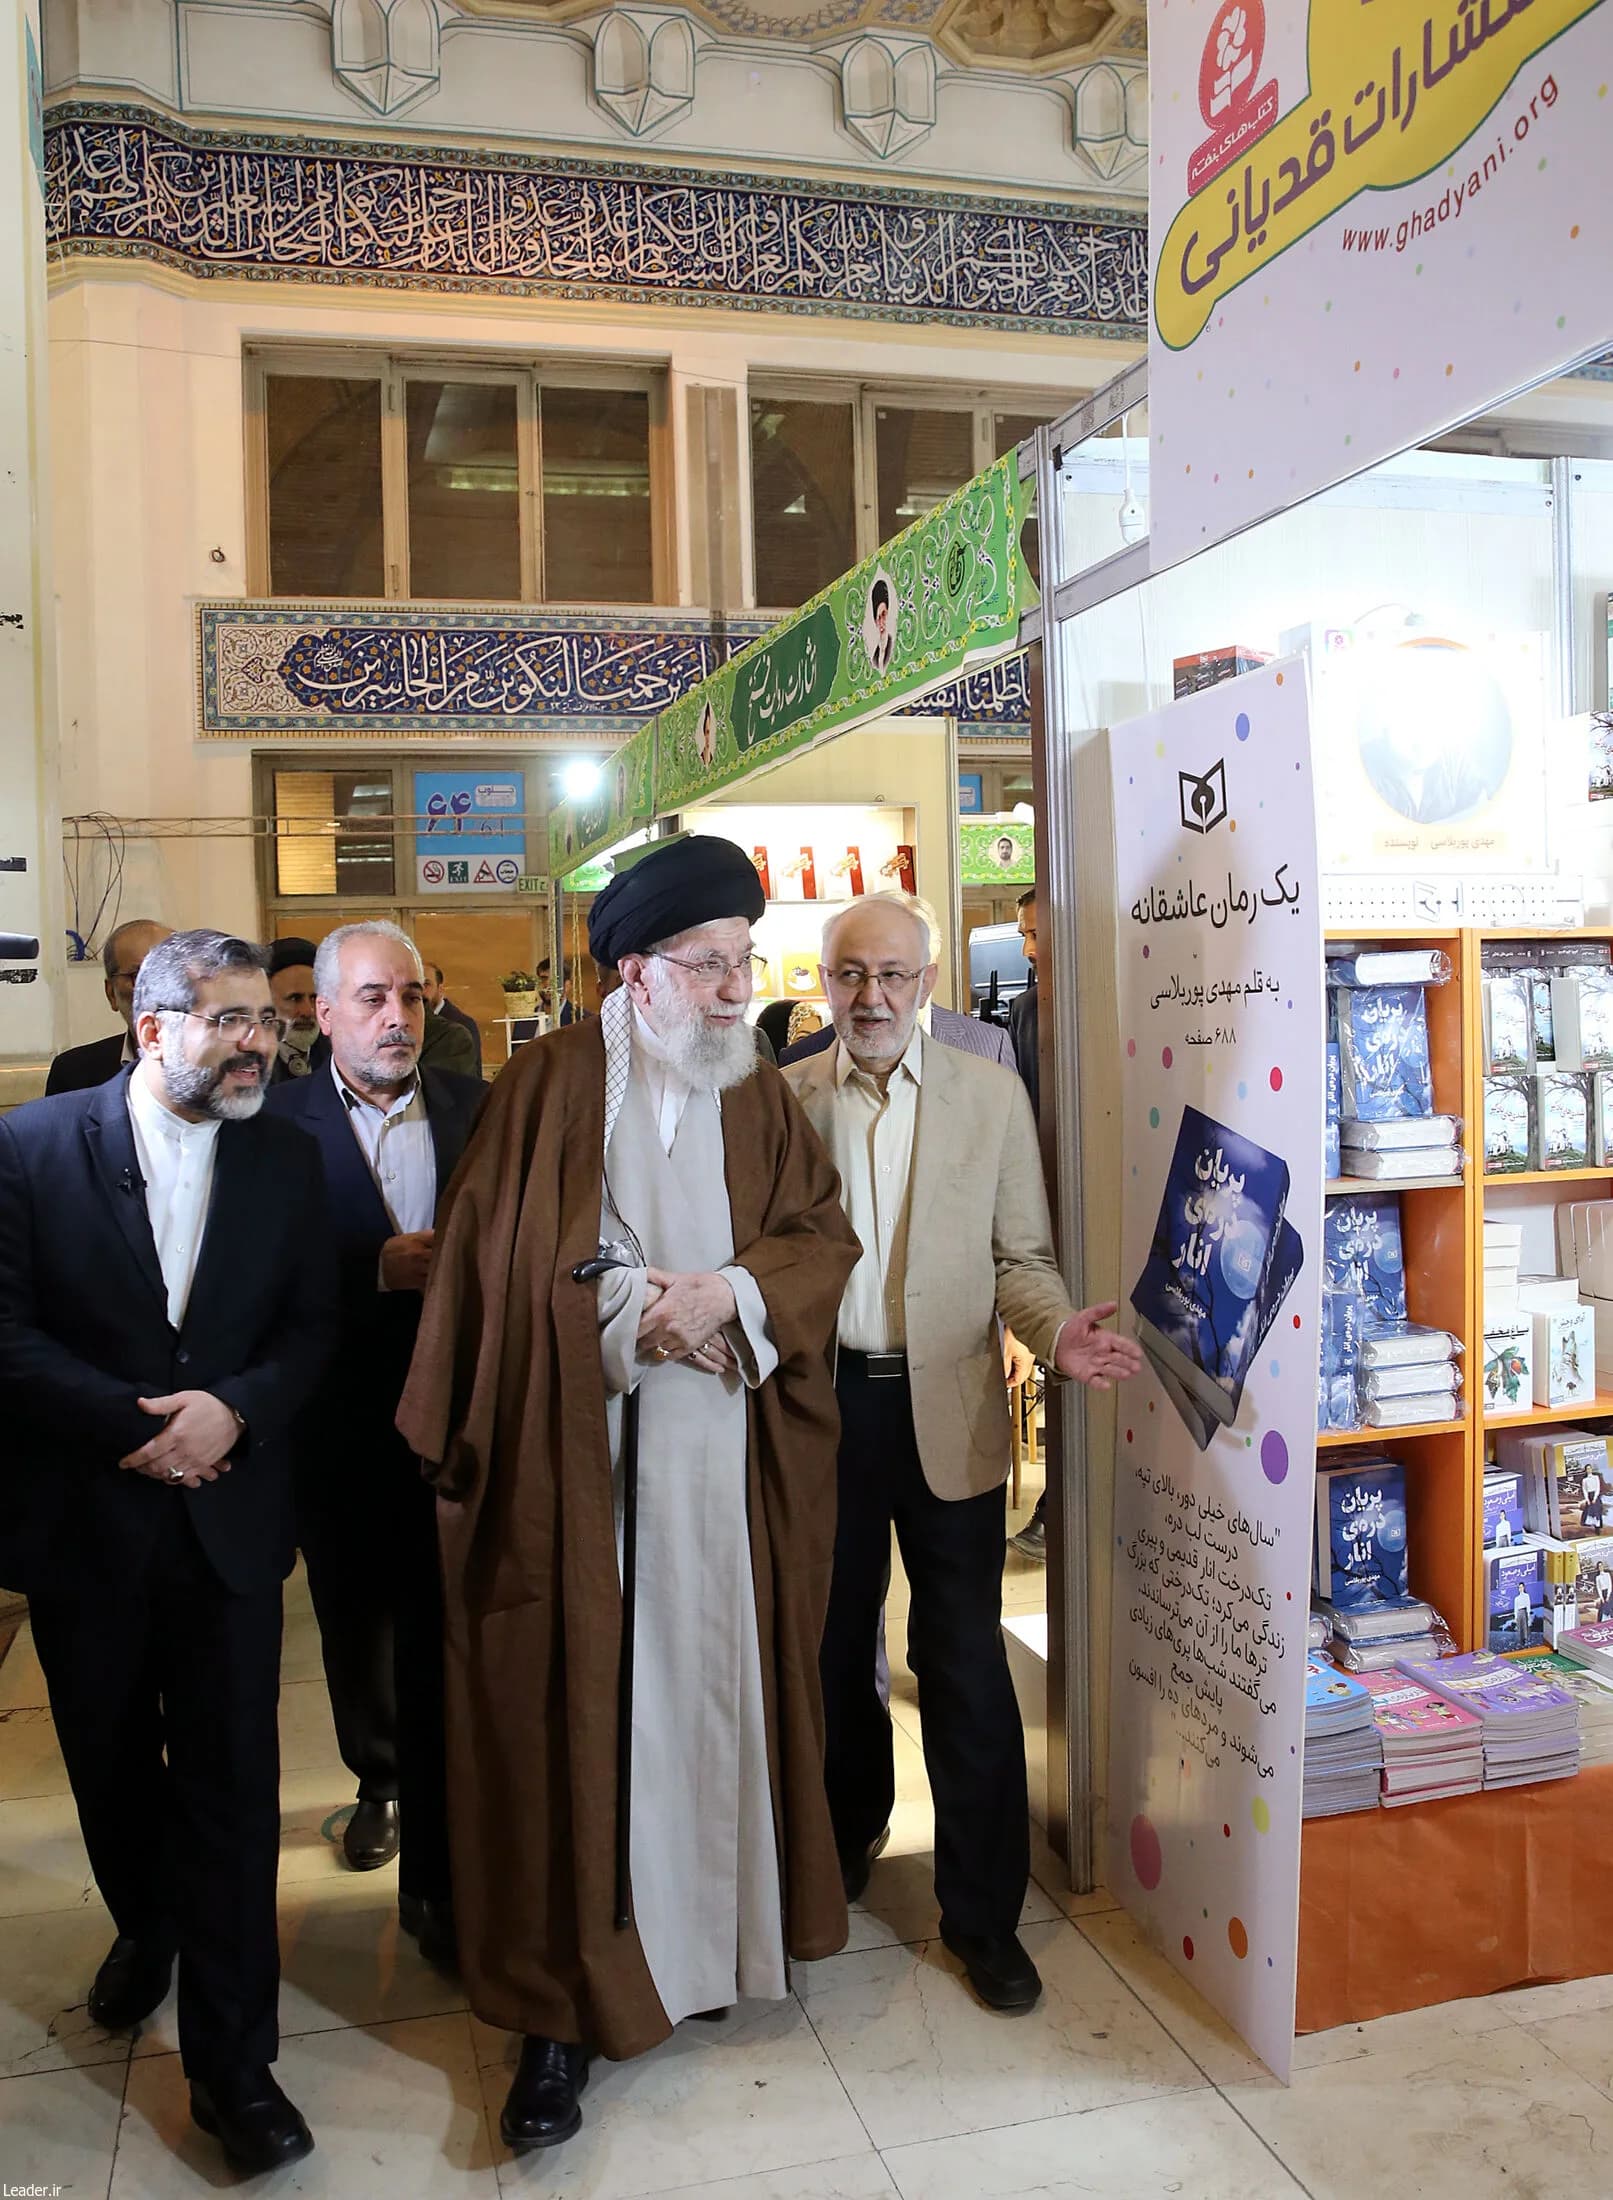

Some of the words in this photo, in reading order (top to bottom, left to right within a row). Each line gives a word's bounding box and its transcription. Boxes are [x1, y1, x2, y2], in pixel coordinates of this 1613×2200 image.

[1342, 74, 1558, 252] www.ghadyani.org
[1181, 108, 1335, 295] قدیانی
[519, 878, 538, 891] EXIT
[1260, 863, 1300, 915] یک
[1131, 880, 1208, 924] عاشقانه
[1210, 872, 1257, 929] رمان
[1150, 973, 1205, 1010] پوربلاسی
[1206, 979, 1242, 1003] مهدی
[1243, 968, 1264, 1008] قلم
[1265, 975, 1280, 1002] به
[1184, 1028, 1213, 1046] صفحه
[1214, 1027, 1237, 1044] ۶۸۸
[1195, 1148, 1246, 1208] پریان
[1335, 1206, 1380, 1233] پریان
[1171, 1232, 1213, 1276] انار
[1152, 1474, 1175, 1501] بالای
[1341, 1486, 1384, 1514] پریان
[1198, 1496, 1225, 1523] خیلی
[1137, 1529, 1158, 1550] پیری
[1185, 1522, 1201, 1541] لب
[1127, 1541, 1147, 1570] بزرگ
[1159, 1539, 1165, 1555] و
[1167, 1547, 1198, 1568] قدیمی
[1204, 1533, 1239, 1562] درست
[1344, 1540, 1373, 1571] انار
[1148, 1558, 1160, 1574] که
[1200, 1556, 1216, 1580] انار
[1129, 1605, 1153, 1634] زیادی
[1195, 1613, 1209, 1637] آن
[1209, 1624, 1219, 1647] از
[1220, 1627, 1228, 1654] را
[1231, 1633, 1242, 1658] ما
[1252, 1620, 1285, 1658] زندگی
[1244, 1642, 1268, 1676] ترها
[1128, 1659, 1158, 1688] افسون
[1159, 1673, 1166, 1700] را
[1170, 1662, 1194, 1689] جمع
[1166, 1687, 1179, 1704] ده
[1195, 1680, 1223, 1714] پایش
[1220, 1731, 1227, 1747] و
